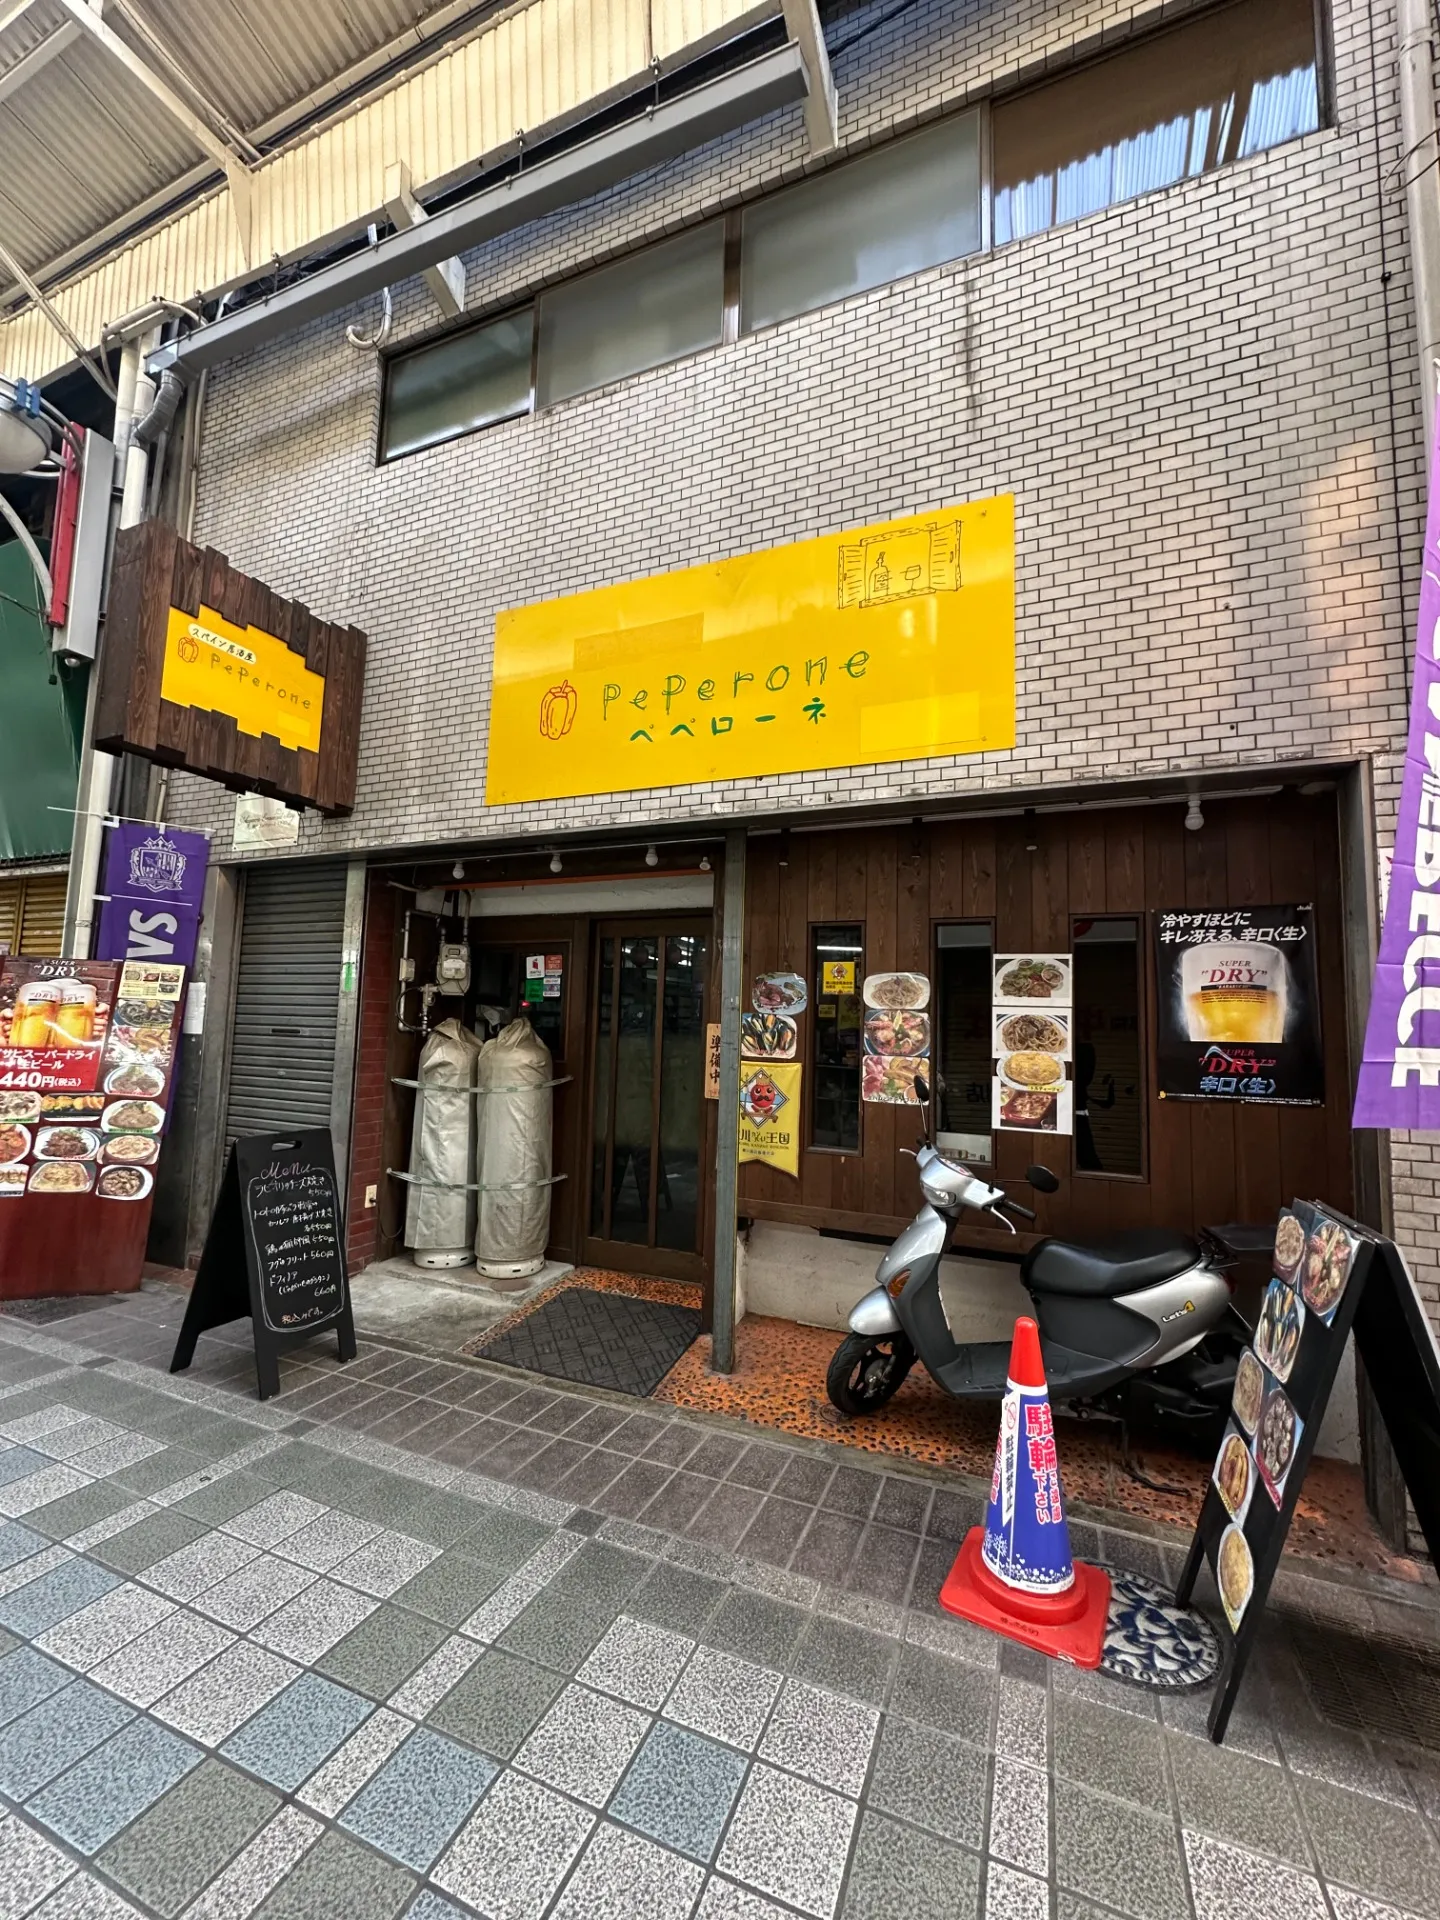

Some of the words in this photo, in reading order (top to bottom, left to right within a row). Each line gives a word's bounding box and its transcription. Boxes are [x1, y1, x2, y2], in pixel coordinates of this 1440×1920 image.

[629, 697, 827, 743] ペペローネ
[1160, 912, 1252, 928] 冷やすほどに
[0, 1048, 96, 1060] サヒスーパードライ
[1033, 1474, 1050, 1525] 下さい
